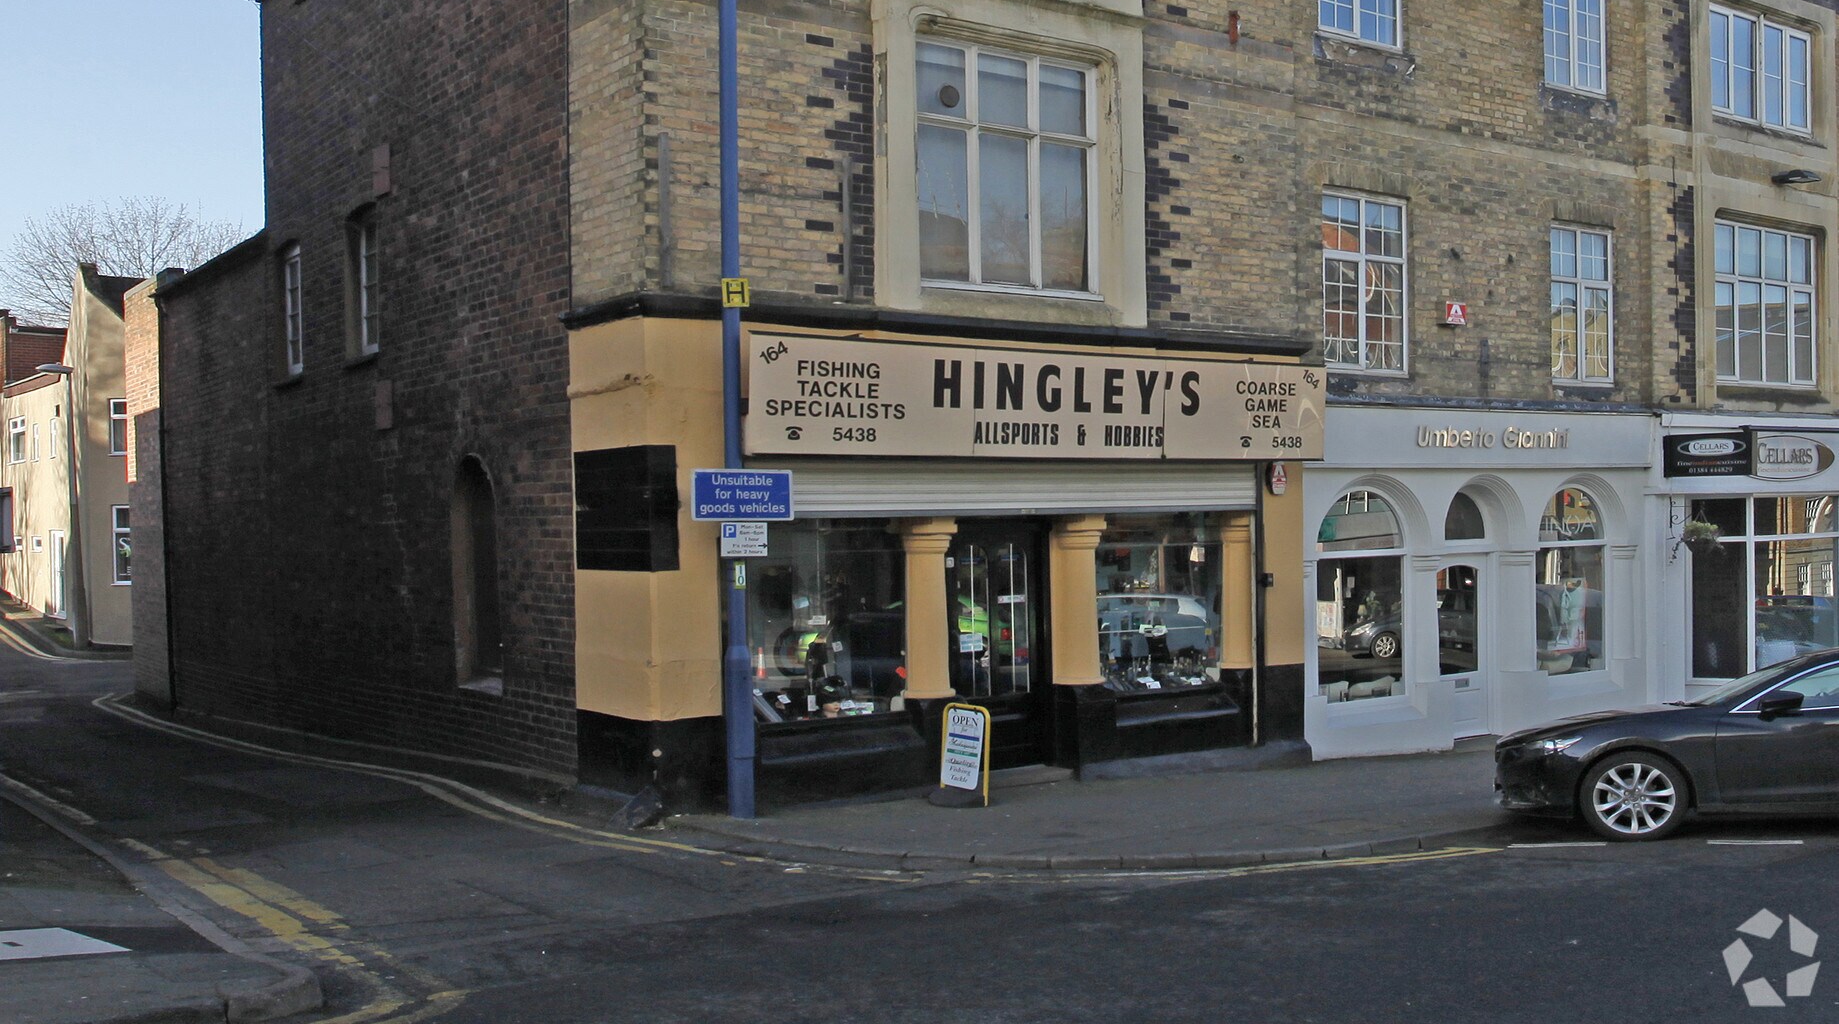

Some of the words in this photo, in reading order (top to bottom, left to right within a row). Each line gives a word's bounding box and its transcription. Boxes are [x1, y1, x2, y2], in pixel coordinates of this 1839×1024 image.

[726, 281, 745, 304] H
[759, 341, 788, 364] 164
[797, 360, 880, 379] FISHING
[1302, 369, 1320, 389] 164
[797, 380, 880, 399] TACKLE
[933, 359, 1201, 416] HINGLEY'S
[1236, 380, 1297, 396] COARSE
[765, 399, 906, 420] SPECIALISTS
[1245, 398, 1287, 413] GAME
[1252, 415, 1281, 428] SEA
[832, 427, 877, 442] 5438
[974, 421, 1059, 446] ALLSPORTS
[1077, 424, 1086, 446] &
[1104, 425, 1164, 447] HOBBIES
[1271, 436, 1302, 448] 5438
[1417, 425, 1496, 449] Umberto
[1502, 426, 1570, 449] Giannini
[711, 474, 773, 486] Unsuitable
[715, 488, 732, 499] for
[736, 488, 770, 501] heavy
[700, 503, 735, 515] goods
[740, 502, 785, 513] vehicles
[725, 525, 735, 537] P
[952, 714, 978, 727] OPEN
